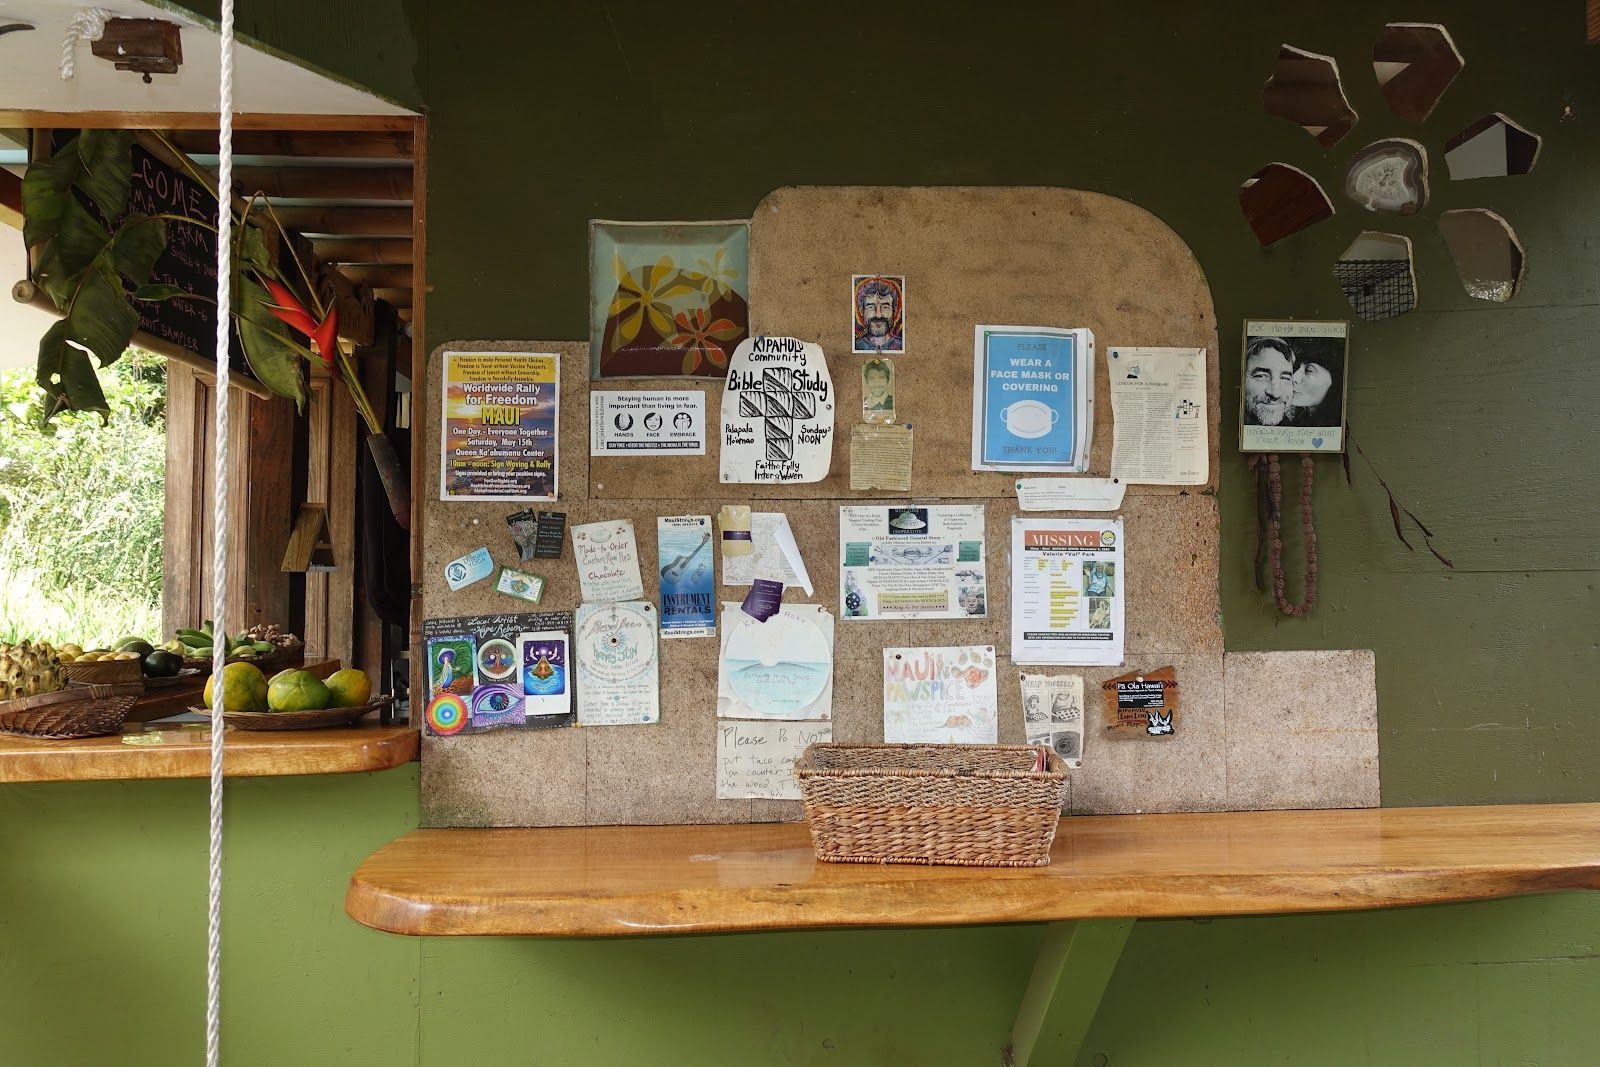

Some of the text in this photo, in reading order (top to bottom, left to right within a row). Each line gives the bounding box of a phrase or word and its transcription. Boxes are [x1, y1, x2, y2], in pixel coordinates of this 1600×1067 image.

[131, 158, 208, 221] COME
[160, 323, 199, 352] SAMPLER
[748, 352, 806, 366] Community
[1010, 358, 1042, 366] WEAR
[991, 370, 1070, 380] FACE MASK OR
[463, 384, 540, 394] Worldwide Rally
[728, 369, 828, 402] Bible Study
[1002, 383, 1058, 392] COVERING
[466, 394, 537, 405] for Freedom
[482, 407, 520, 425] MAUI
[468, 428, 480, 436] Day
[488, 428, 518, 436] Everyone
[518, 428, 548, 436] Together
[726, 423, 832, 438] Palapala Sundays
[467, 438, 532, 447] Saturday, May 15th
[798, 434, 821, 445] NOON
[456, 448, 478, 456] Queen
[522, 449, 544, 457] Center
[1002, 446, 1032, 454] THANK
[491, 460, 504, 468] Sign
[506, 460, 528, 468] Waving
[536, 460, 552, 469] Rally
[1032, 534, 1093, 546] MISSING
[588, 568, 625, 580] Chocolate
[664, 593, 710, 606] INSTRUMENT
[664, 606, 711, 615] RENTALS
[468, 617, 490, 626] Local
[493, 616, 518, 624] Artist
[887, 680, 965, 702] PAWSPICE
[724, 726, 768, 748] Please
[799, 730, 824, 744] NOT
[749, 754, 772, 764] taco
[720, 779, 770, 788] the wood
